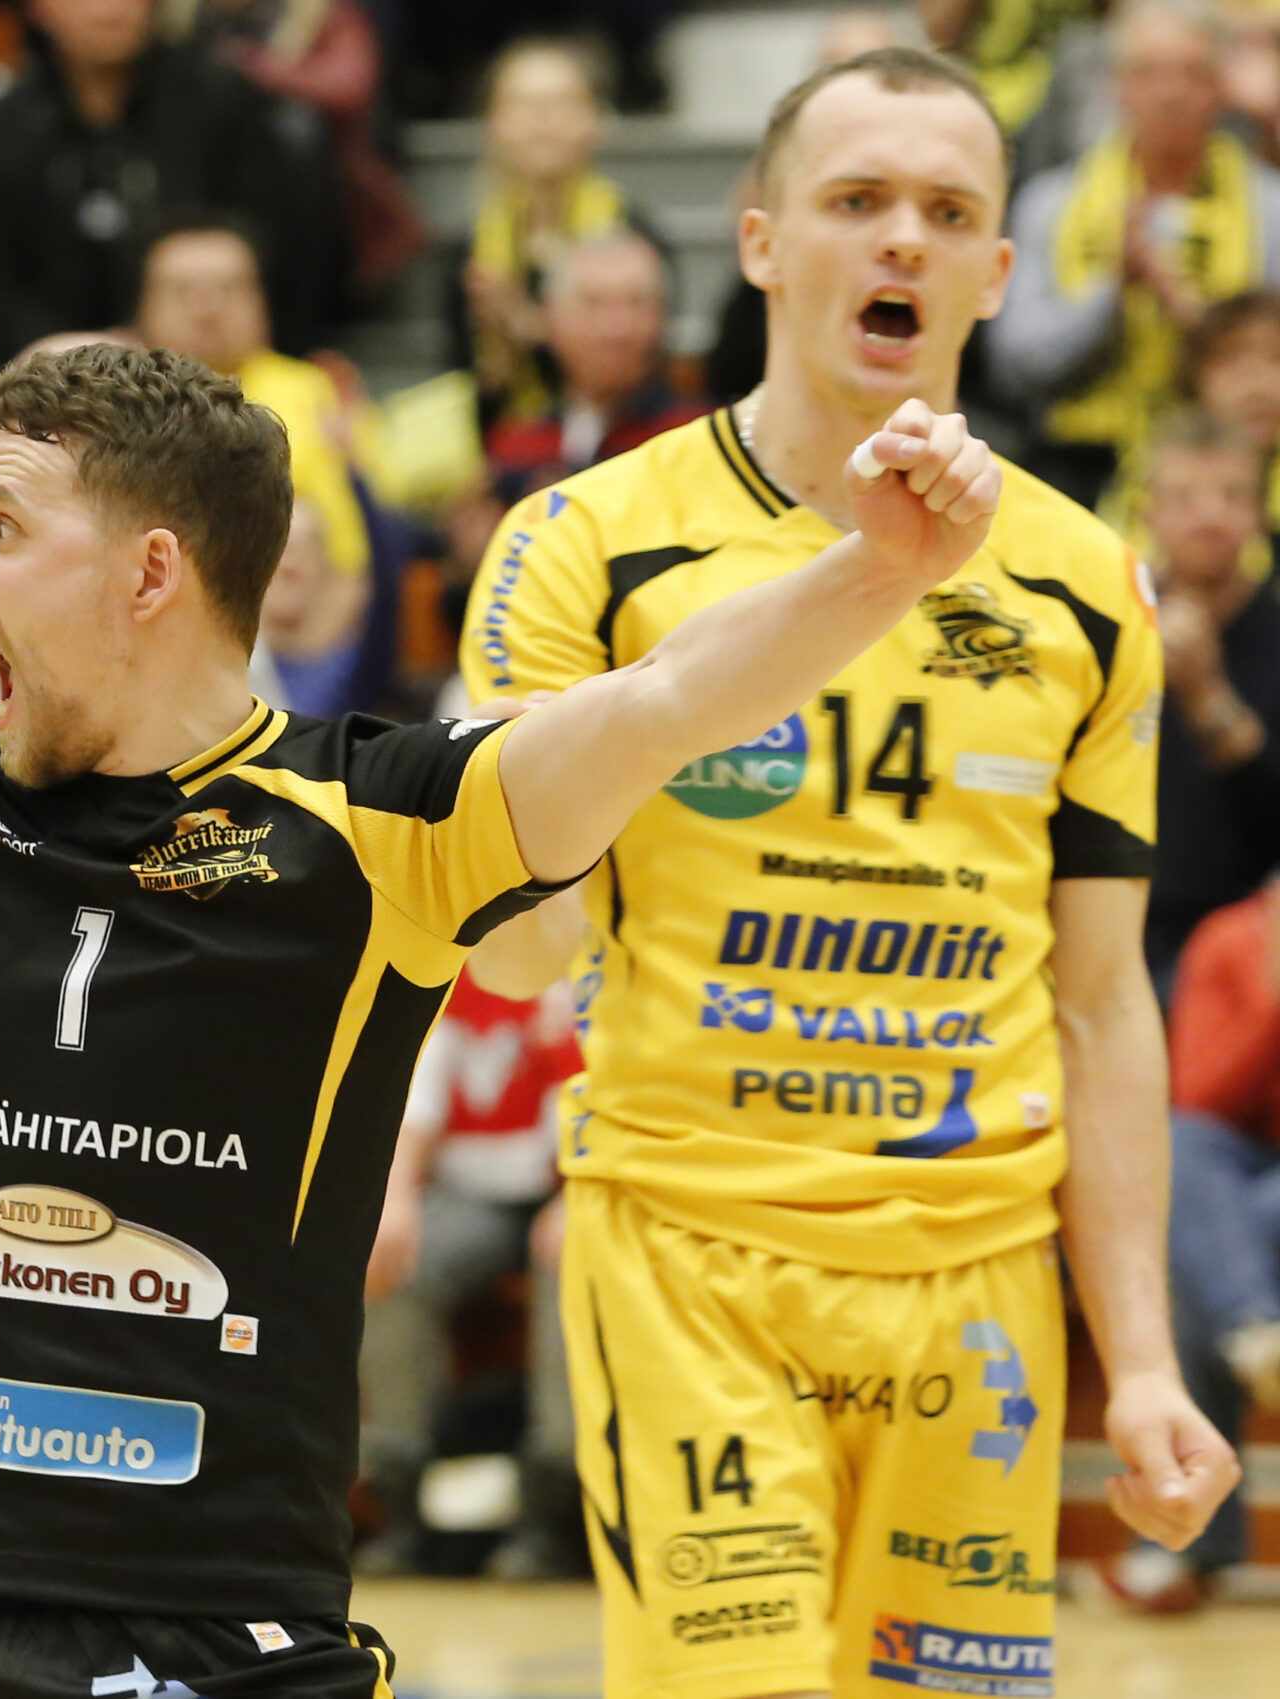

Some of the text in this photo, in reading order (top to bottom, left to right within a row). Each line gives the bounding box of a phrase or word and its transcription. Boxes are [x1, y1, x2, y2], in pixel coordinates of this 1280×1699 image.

[822, 690, 937, 822] 14
[140, 822, 274, 867] Hurrikaani
[144, 874, 173, 890] TEAM
[175, 870, 201, 886] WITH
[203, 866, 220, 881] THE
[54, 906, 115, 1051] 1
[47, 1206, 98, 1232] TIILI
[129, 1268, 190, 1314] Oy
[677, 1435, 753, 1514] 14
[921, 1634, 1055, 1671] RAUTI
